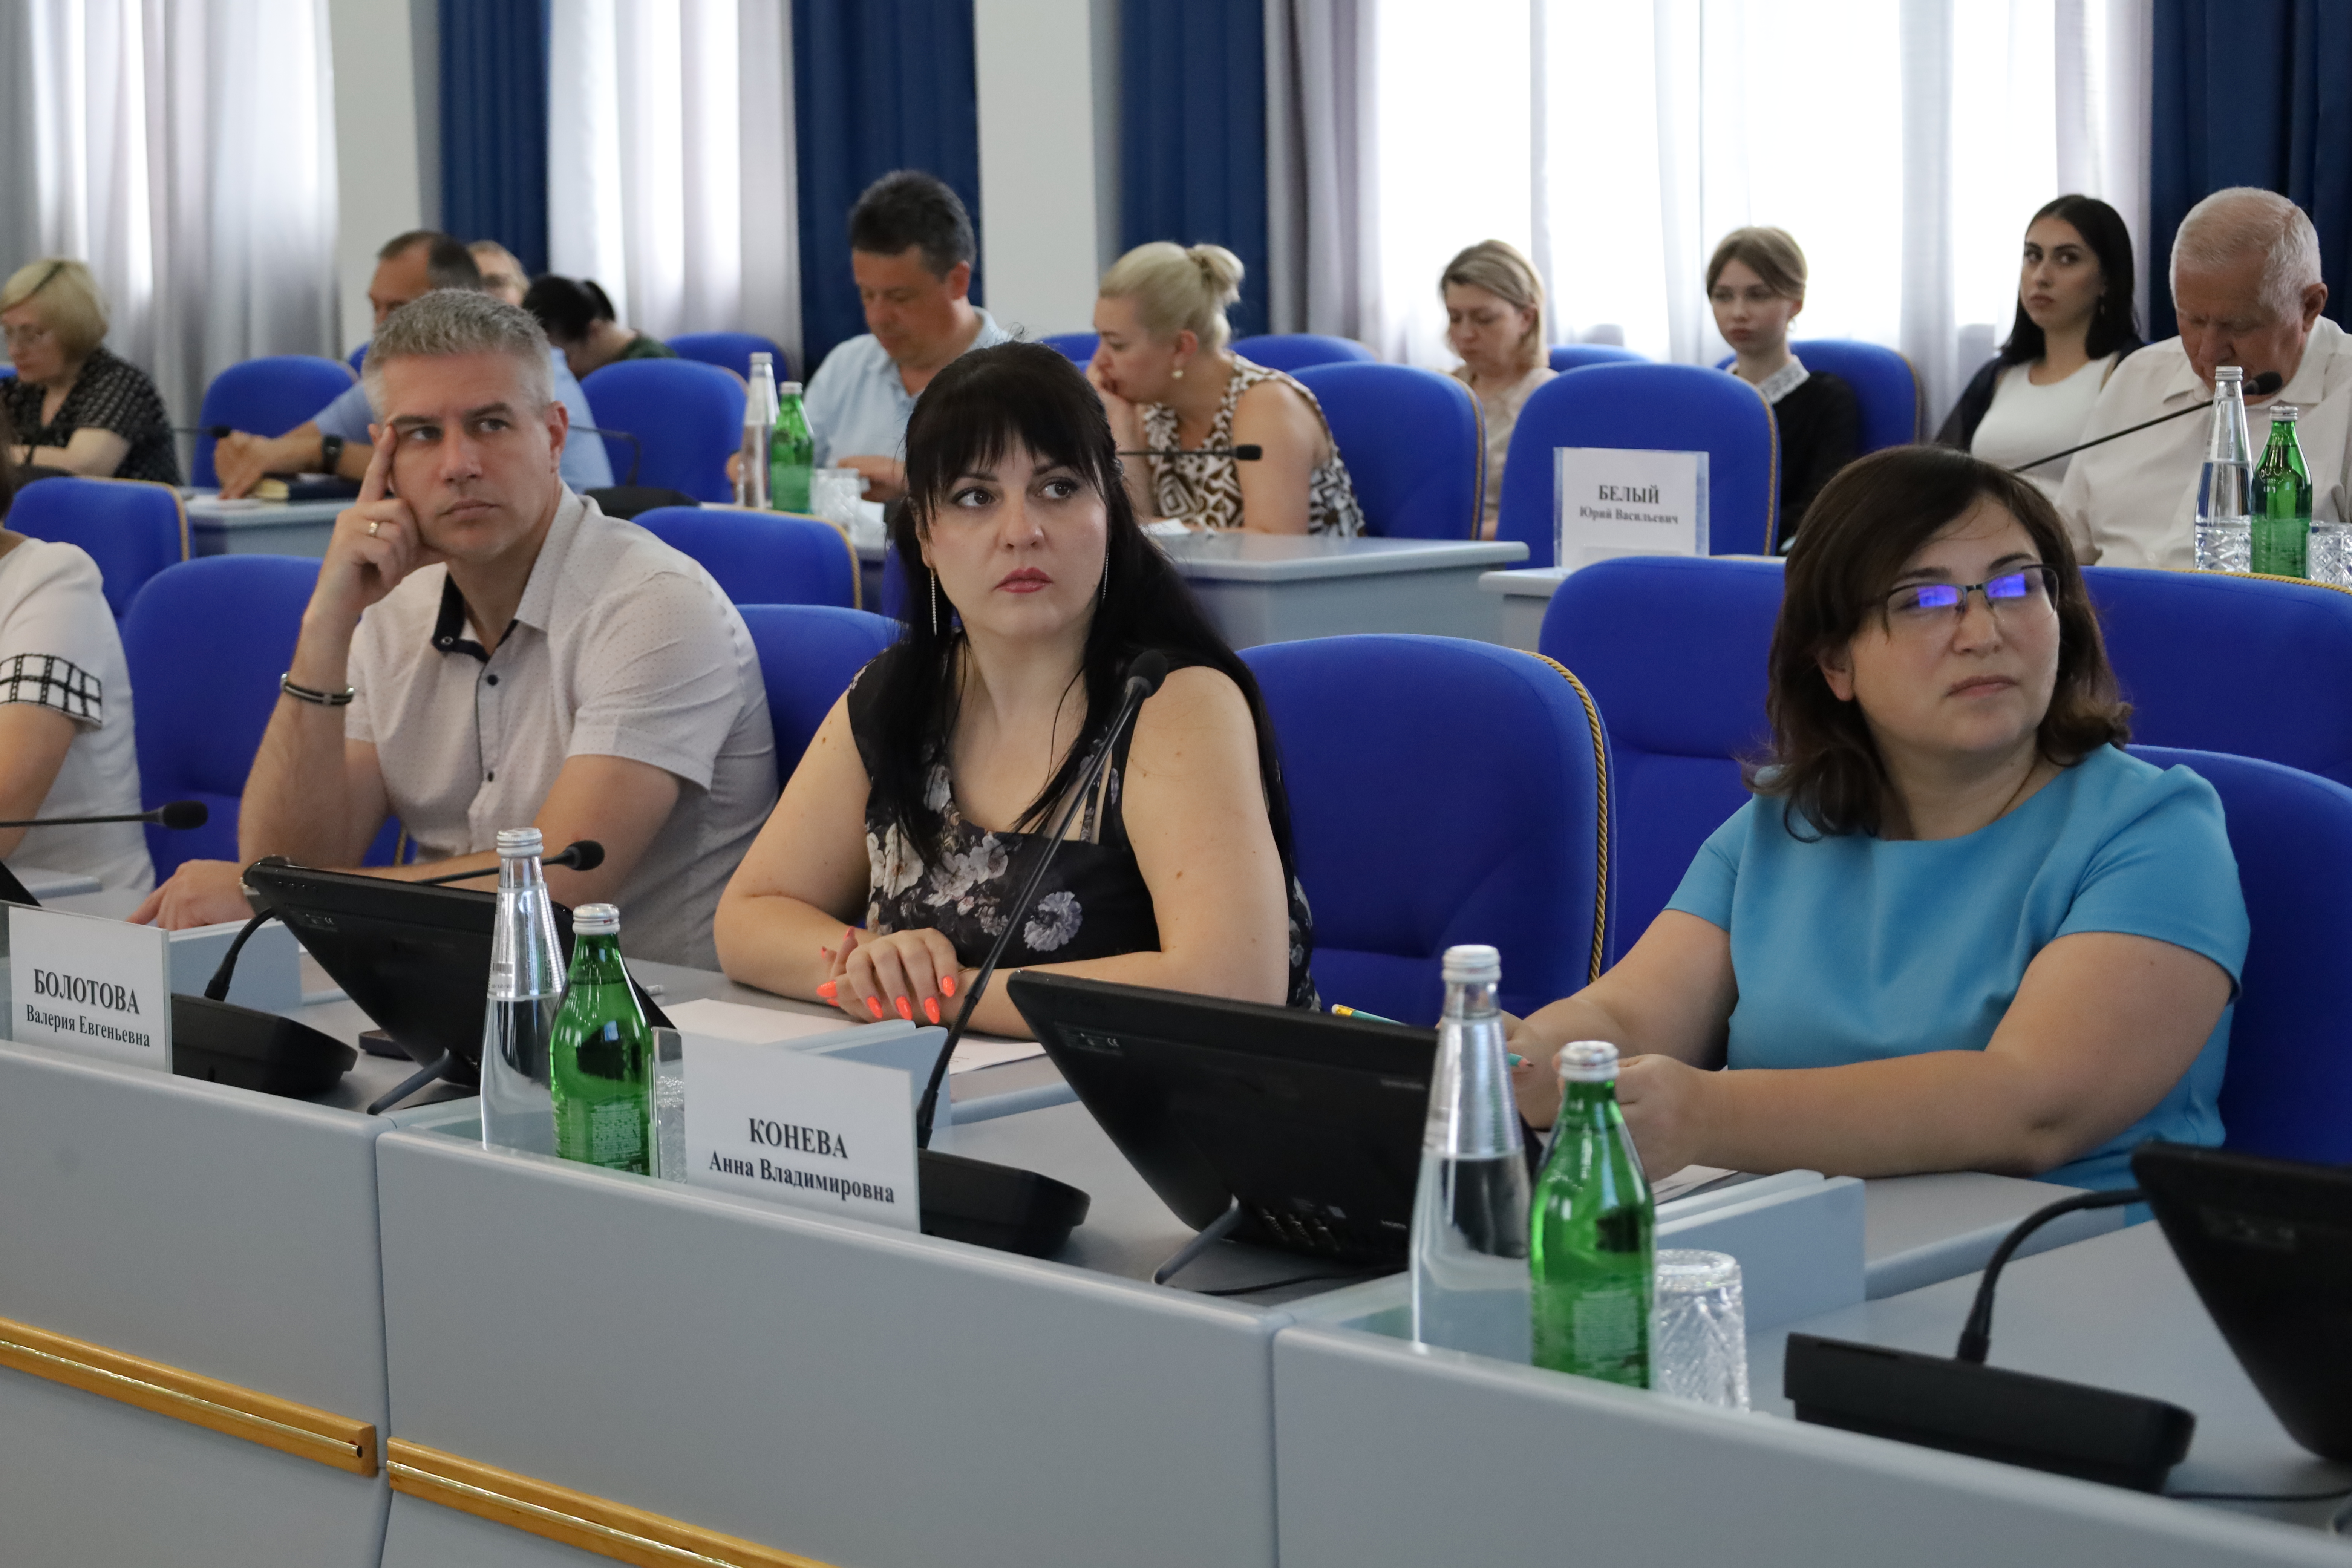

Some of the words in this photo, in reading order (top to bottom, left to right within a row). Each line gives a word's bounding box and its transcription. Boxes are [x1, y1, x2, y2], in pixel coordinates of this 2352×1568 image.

[1580, 505, 1612, 521] Юрий
[1615, 508, 1678, 525] Васильевич
[1599, 485, 1659, 504] БЕЛЫЙ
[34, 968, 140, 1015] БОЛОТОВА
[26, 1004, 75, 1032] Валерия
[79, 1015, 150, 1047] Евгеньевна
[749, 1118, 848, 1159] КОНЕВА
[709, 1150, 754, 1178] Анна
[759, 1158, 894, 1204] Владимировна
